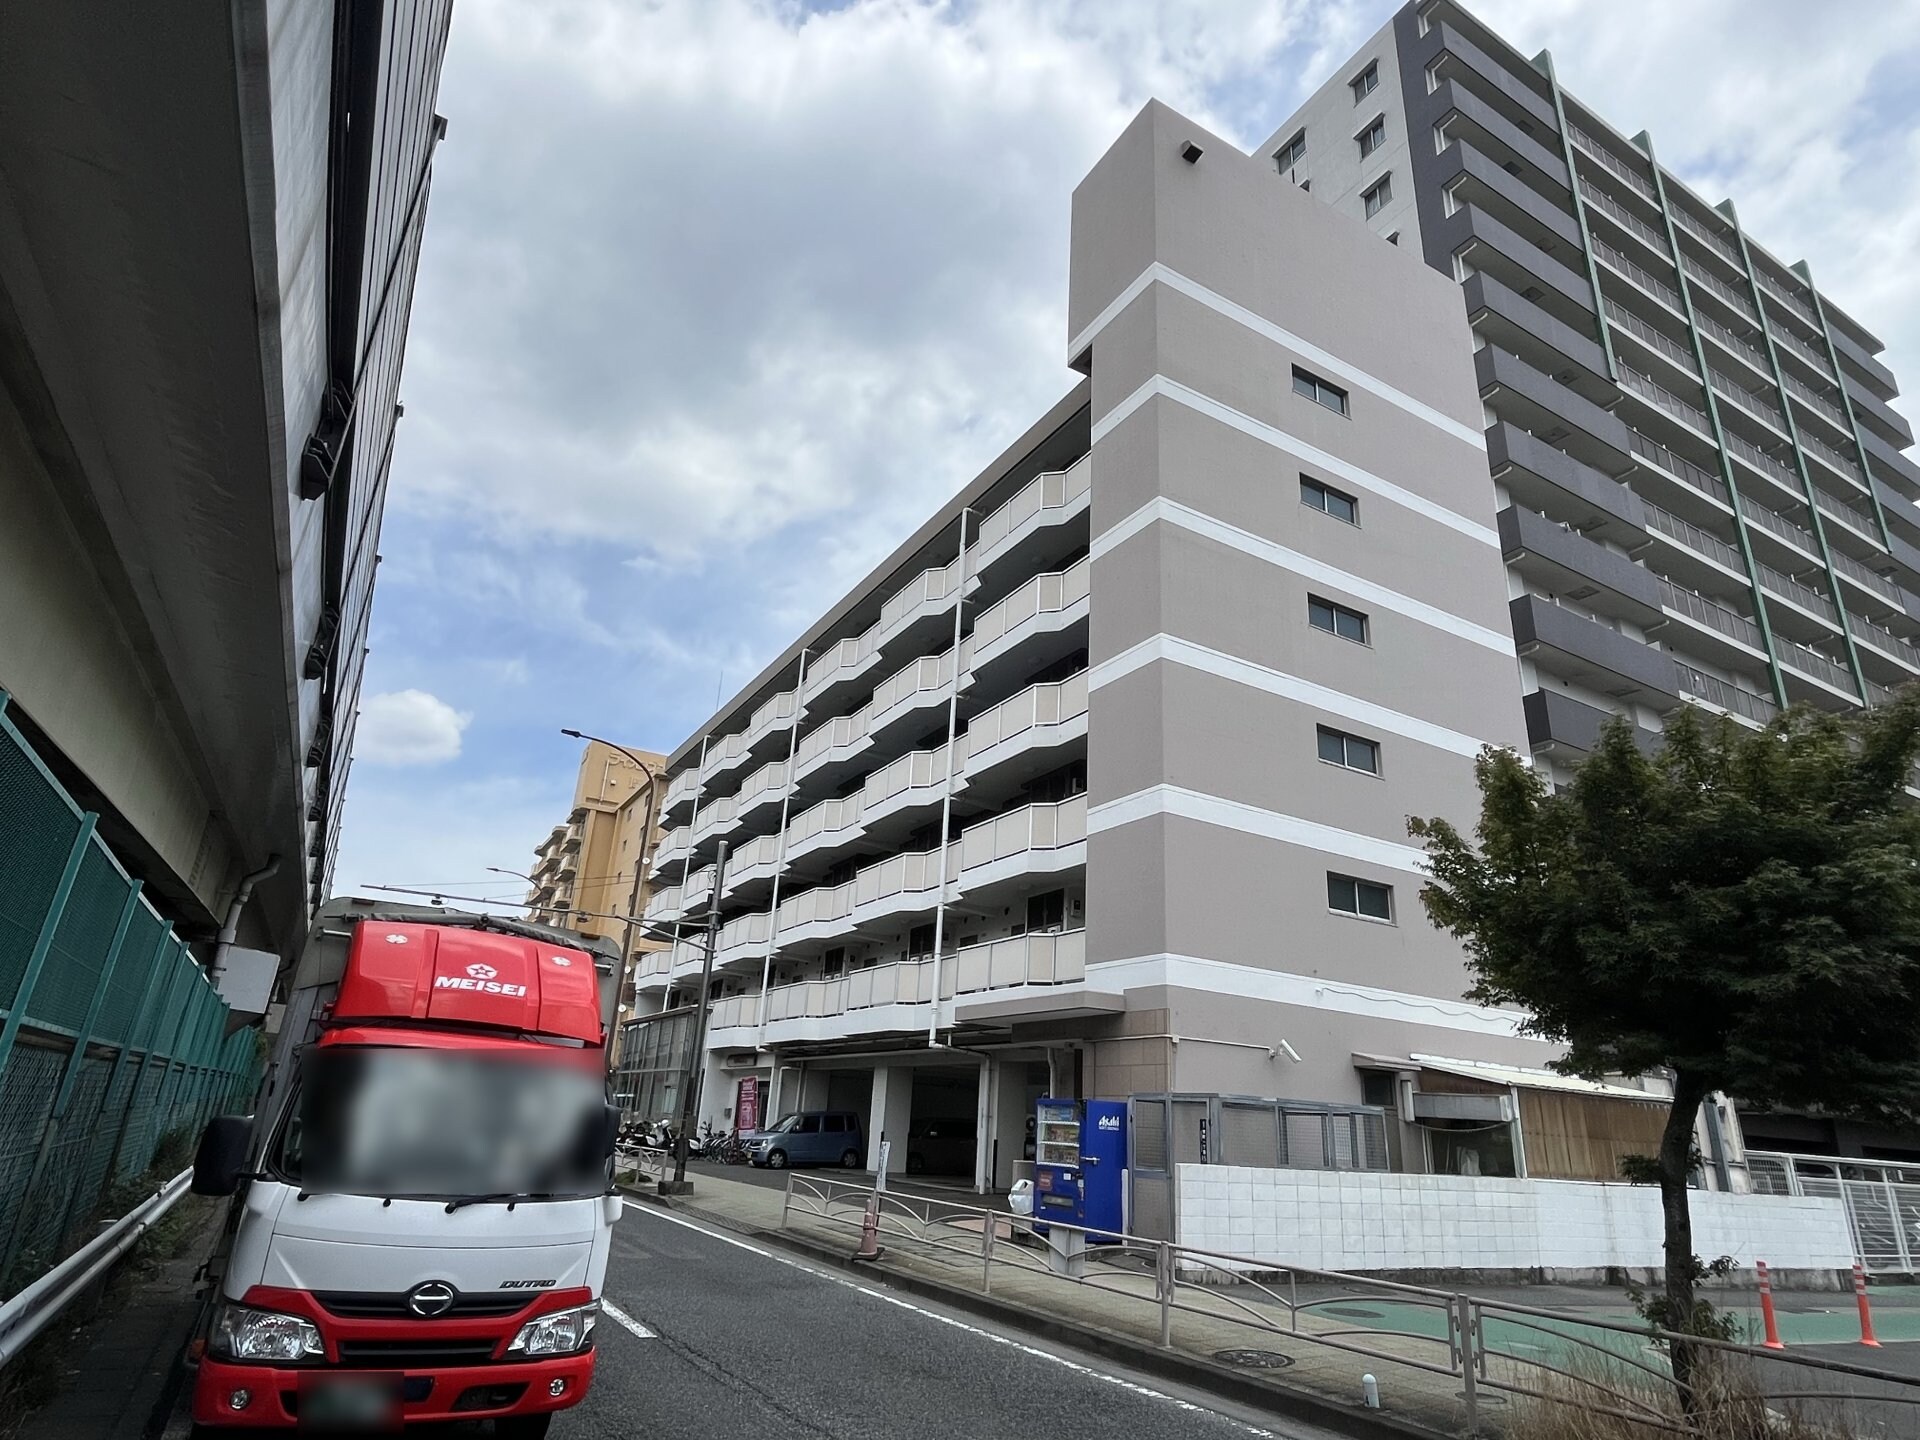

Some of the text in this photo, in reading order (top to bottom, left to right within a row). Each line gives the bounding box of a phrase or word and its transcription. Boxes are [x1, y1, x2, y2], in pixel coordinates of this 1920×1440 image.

[435, 976, 527, 997] MEISEI
[1098, 1115, 1119, 1127] Asahi
[499, 1280, 557, 1289] DUTRO
